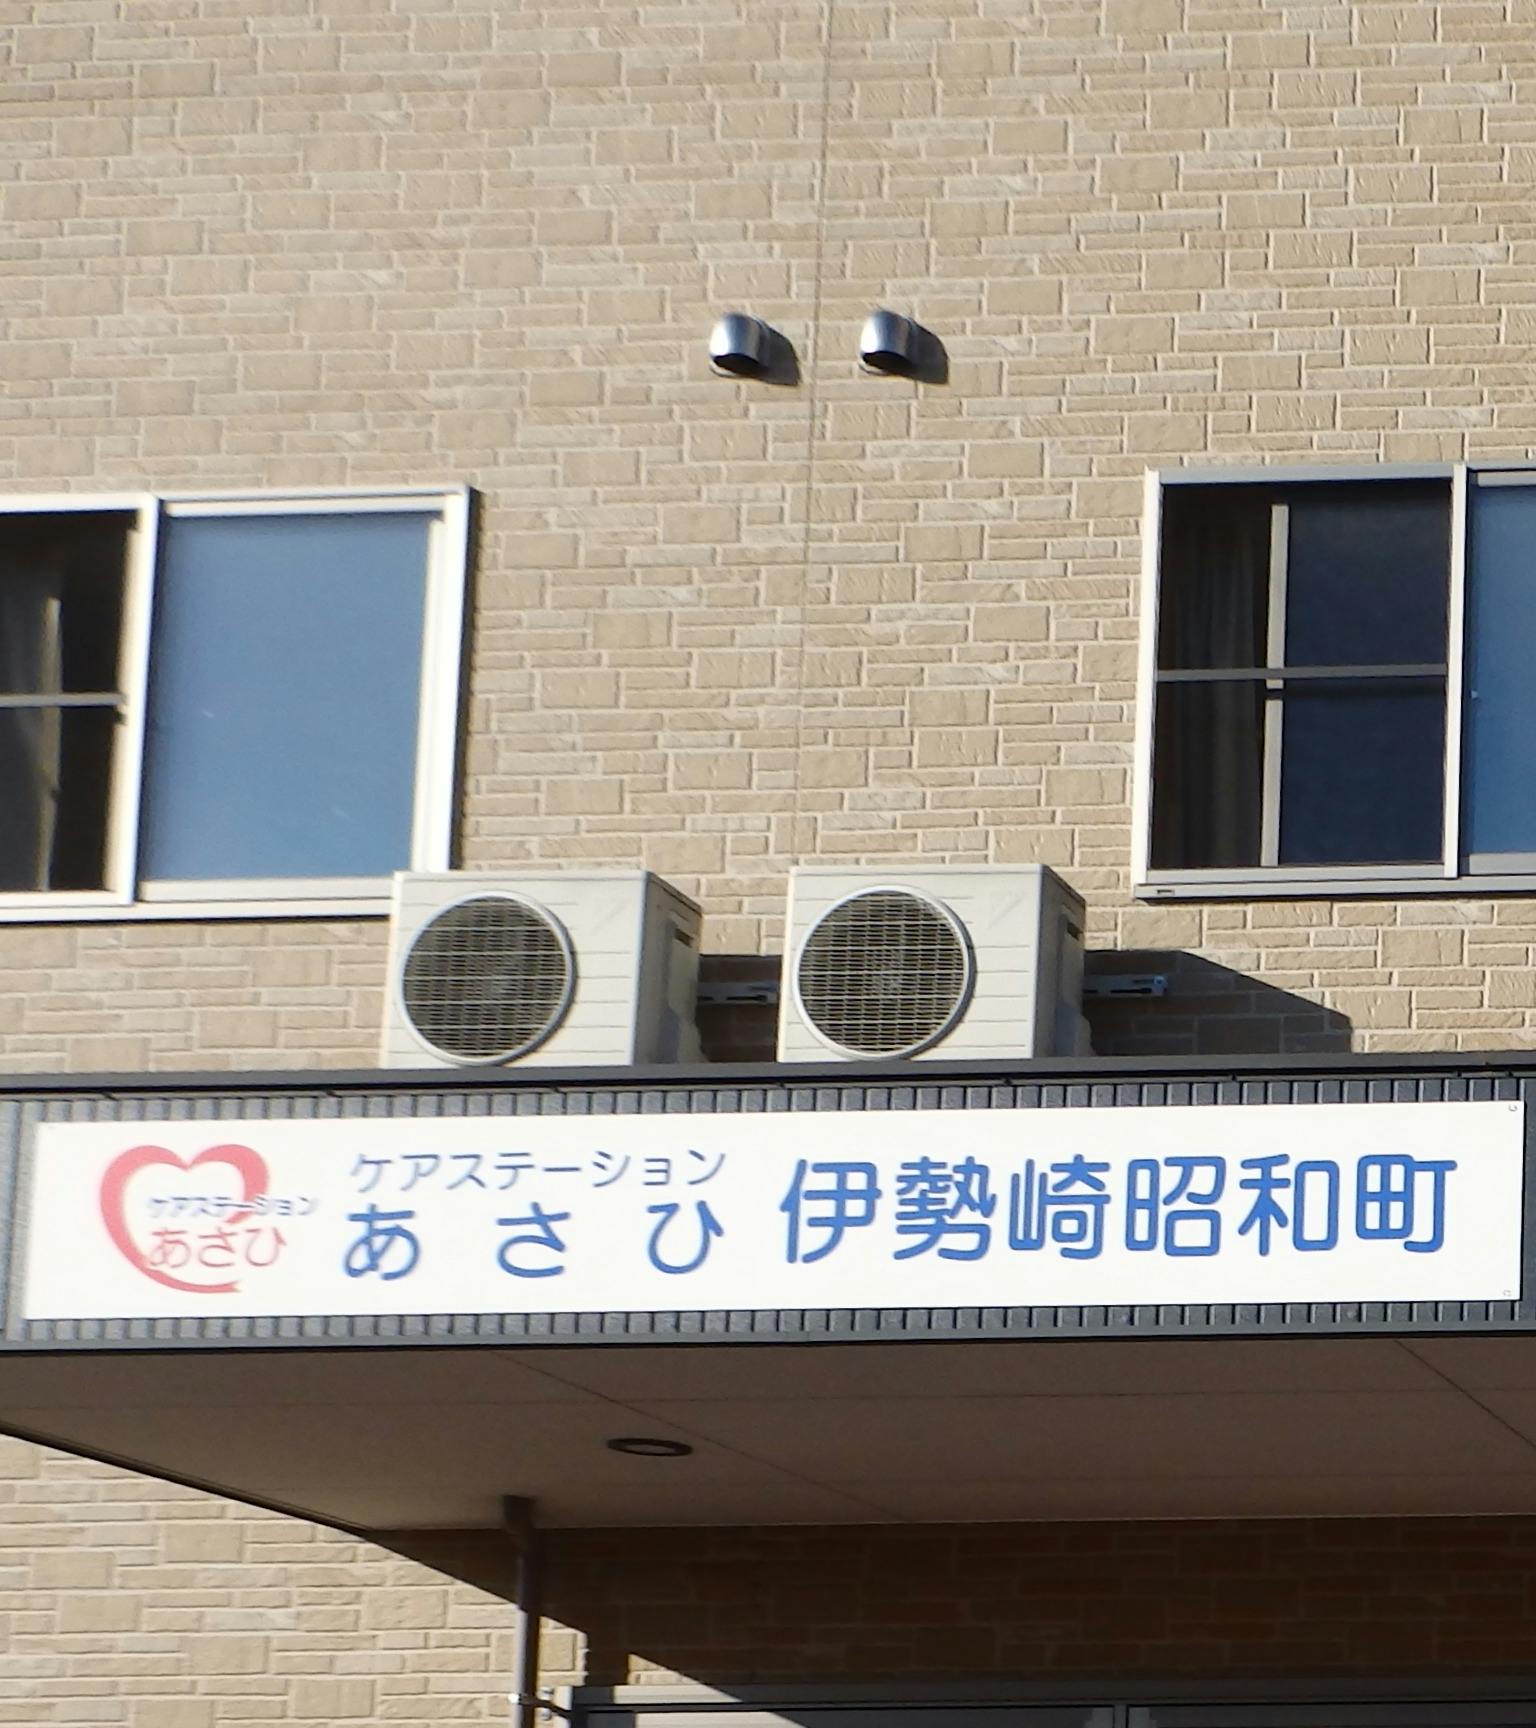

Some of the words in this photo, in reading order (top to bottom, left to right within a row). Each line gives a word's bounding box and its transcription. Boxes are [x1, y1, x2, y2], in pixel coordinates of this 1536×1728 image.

[350, 1150, 727, 1193] ケアステーション
[148, 1195, 318, 1218] ケアステーション
[779, 1153, 1458, 1264] 伊勢崎昭和町
[149, 1225, 287, 1269] あさひ
